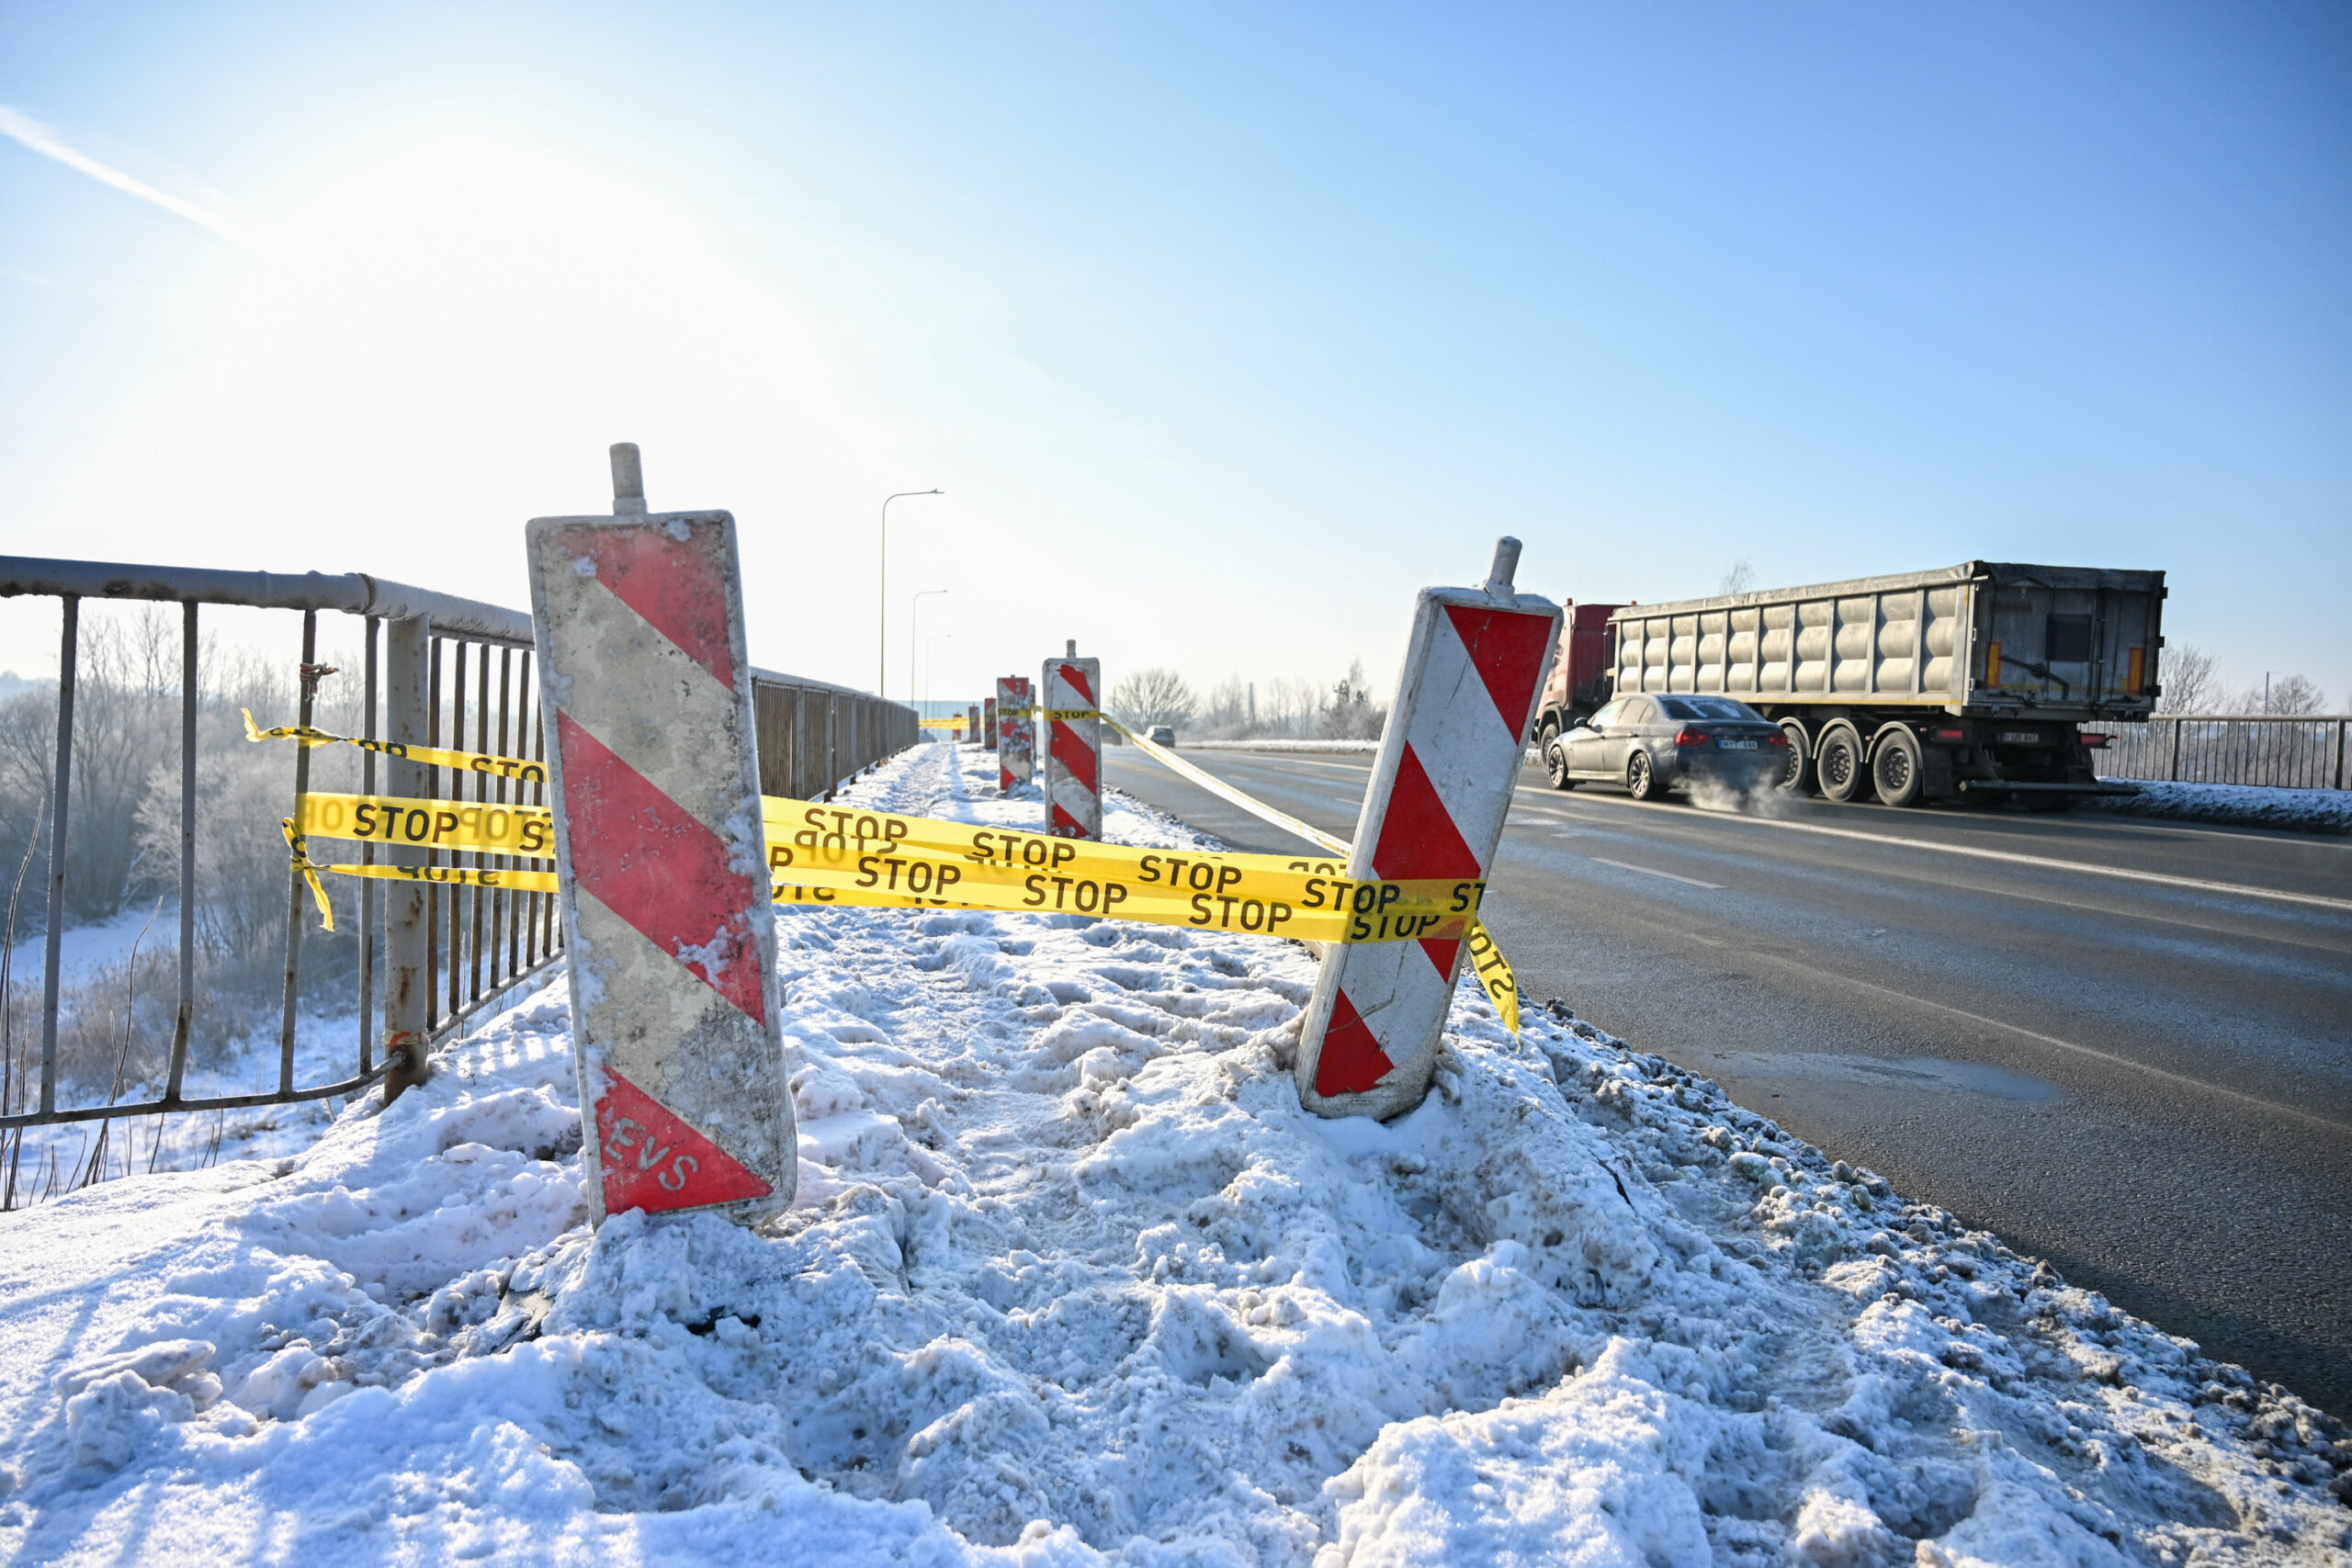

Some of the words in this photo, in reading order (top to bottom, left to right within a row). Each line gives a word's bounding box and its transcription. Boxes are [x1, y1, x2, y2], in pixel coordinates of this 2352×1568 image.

[997, 708, 1020, 716] STOP
[1054, 711, 1090, 720] STOP
[353, 804, 458, 843] STOP
[805, 808, 908, 841] STOP
[972, 831, 1076, 869] STOP
[1137, 855, 1242, 894] STOP
[1301, 878, 1401, 914] STOP
[1450, 883, 1487, 911] ST
[855, 856, 961, 896] STOP
[1023, 874, 1127, 914] STOP
[1189, 893, 1293, 932] STOP
[1351, 916, 1440, 941] STOP
